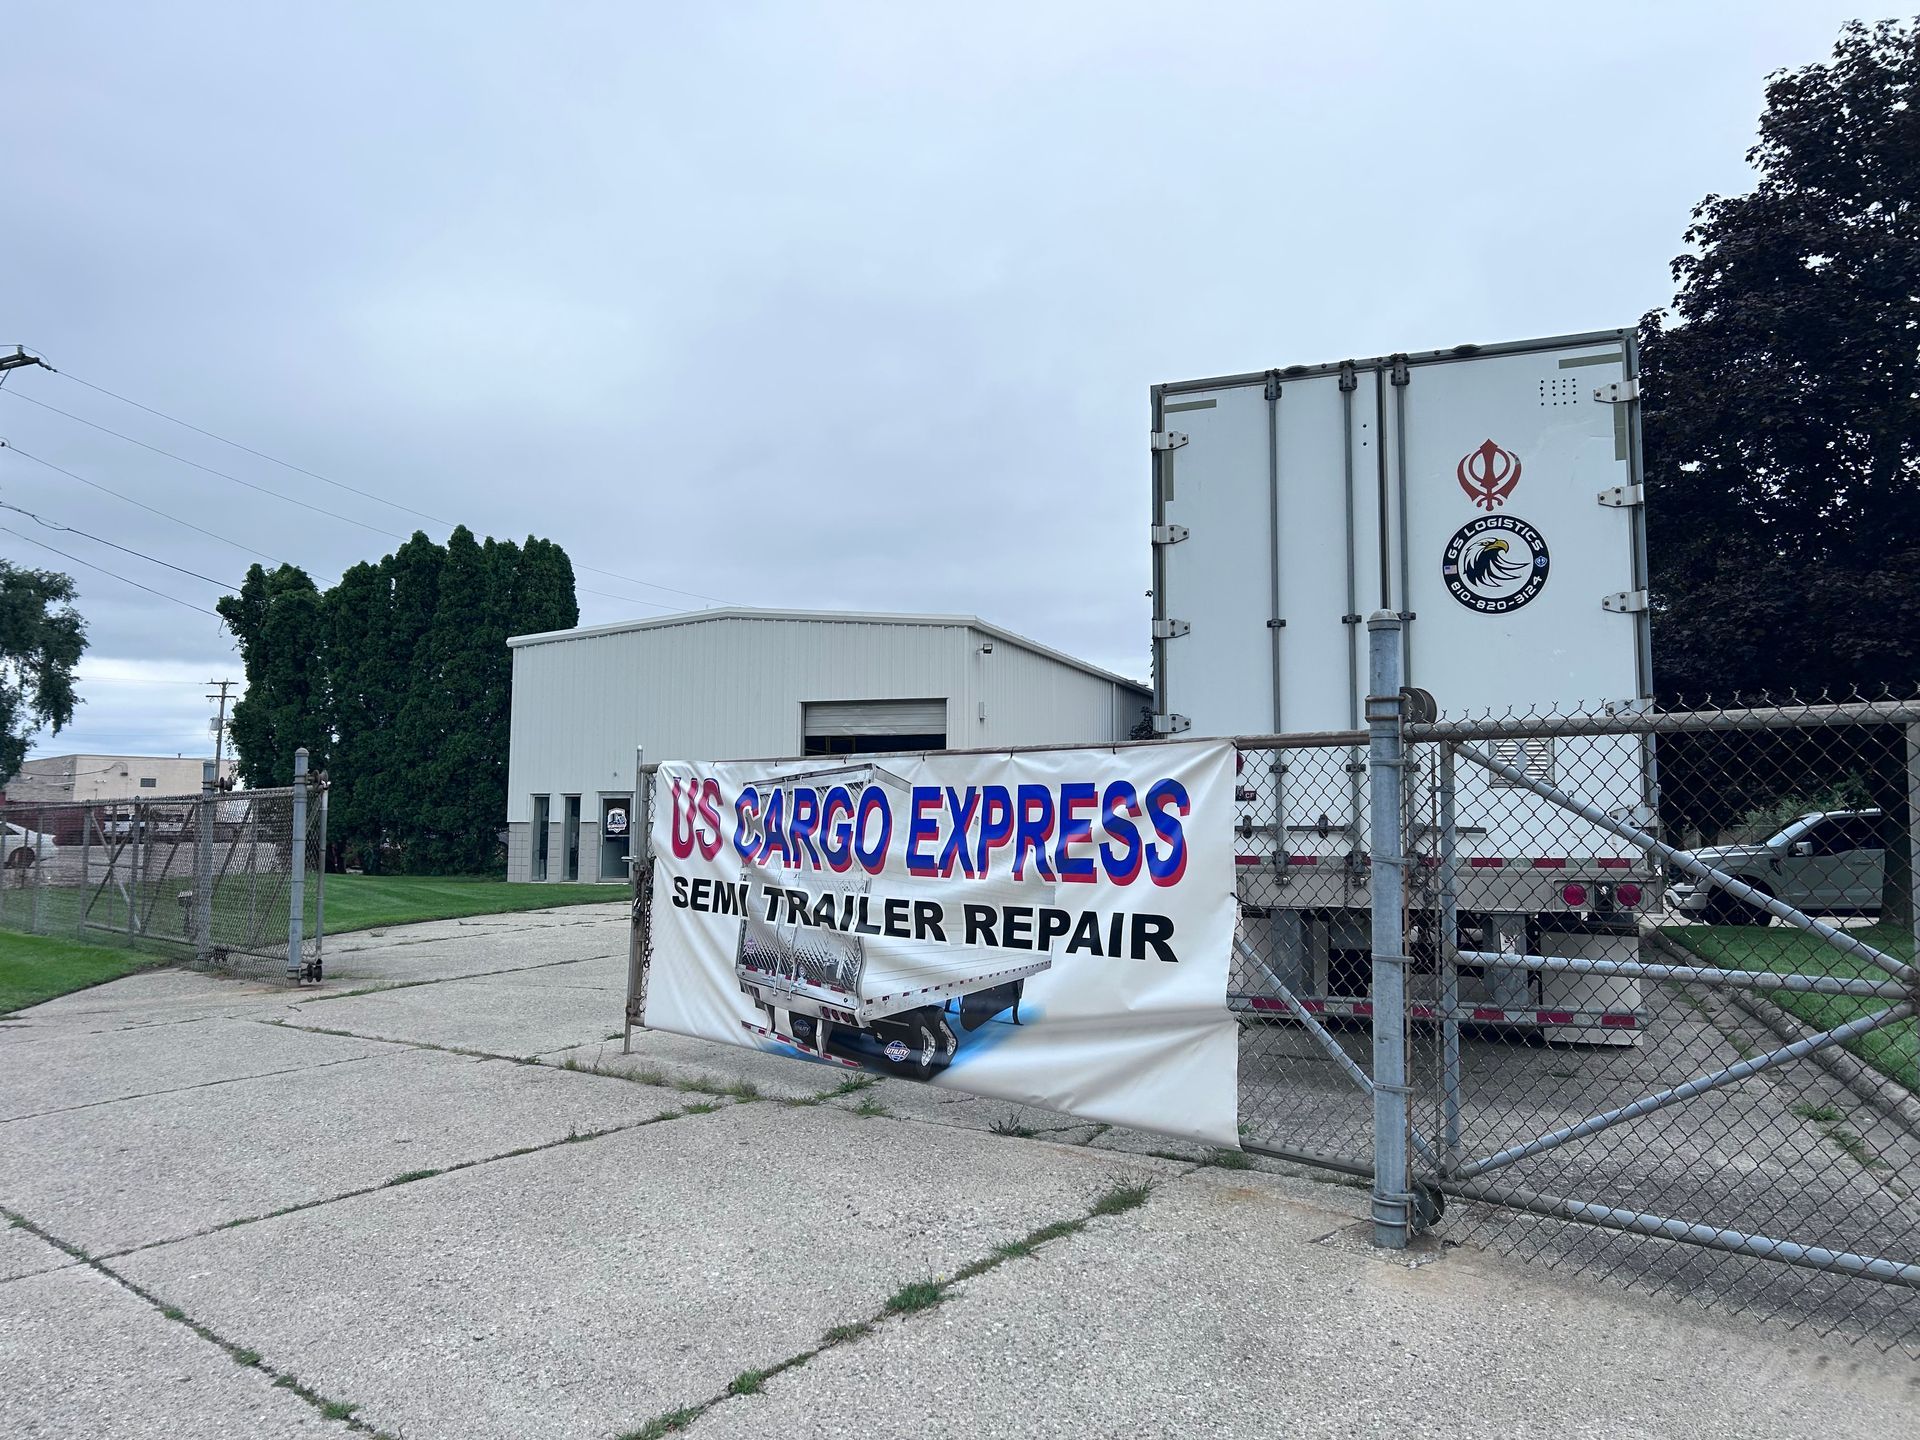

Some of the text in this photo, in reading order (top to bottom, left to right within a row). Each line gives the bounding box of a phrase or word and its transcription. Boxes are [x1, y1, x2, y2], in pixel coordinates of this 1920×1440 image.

[1447, 517, 1544, 559] GS LOGISTICS
[1450, 575, 1542, 611] 810-820-3124
[671, 776, 1190, 887] US CARGO EXPRESS
[672, 876, 1179, 962] SEMI TRAILER REPAIR
[886, 1047, 908, 1056] UTILITY
